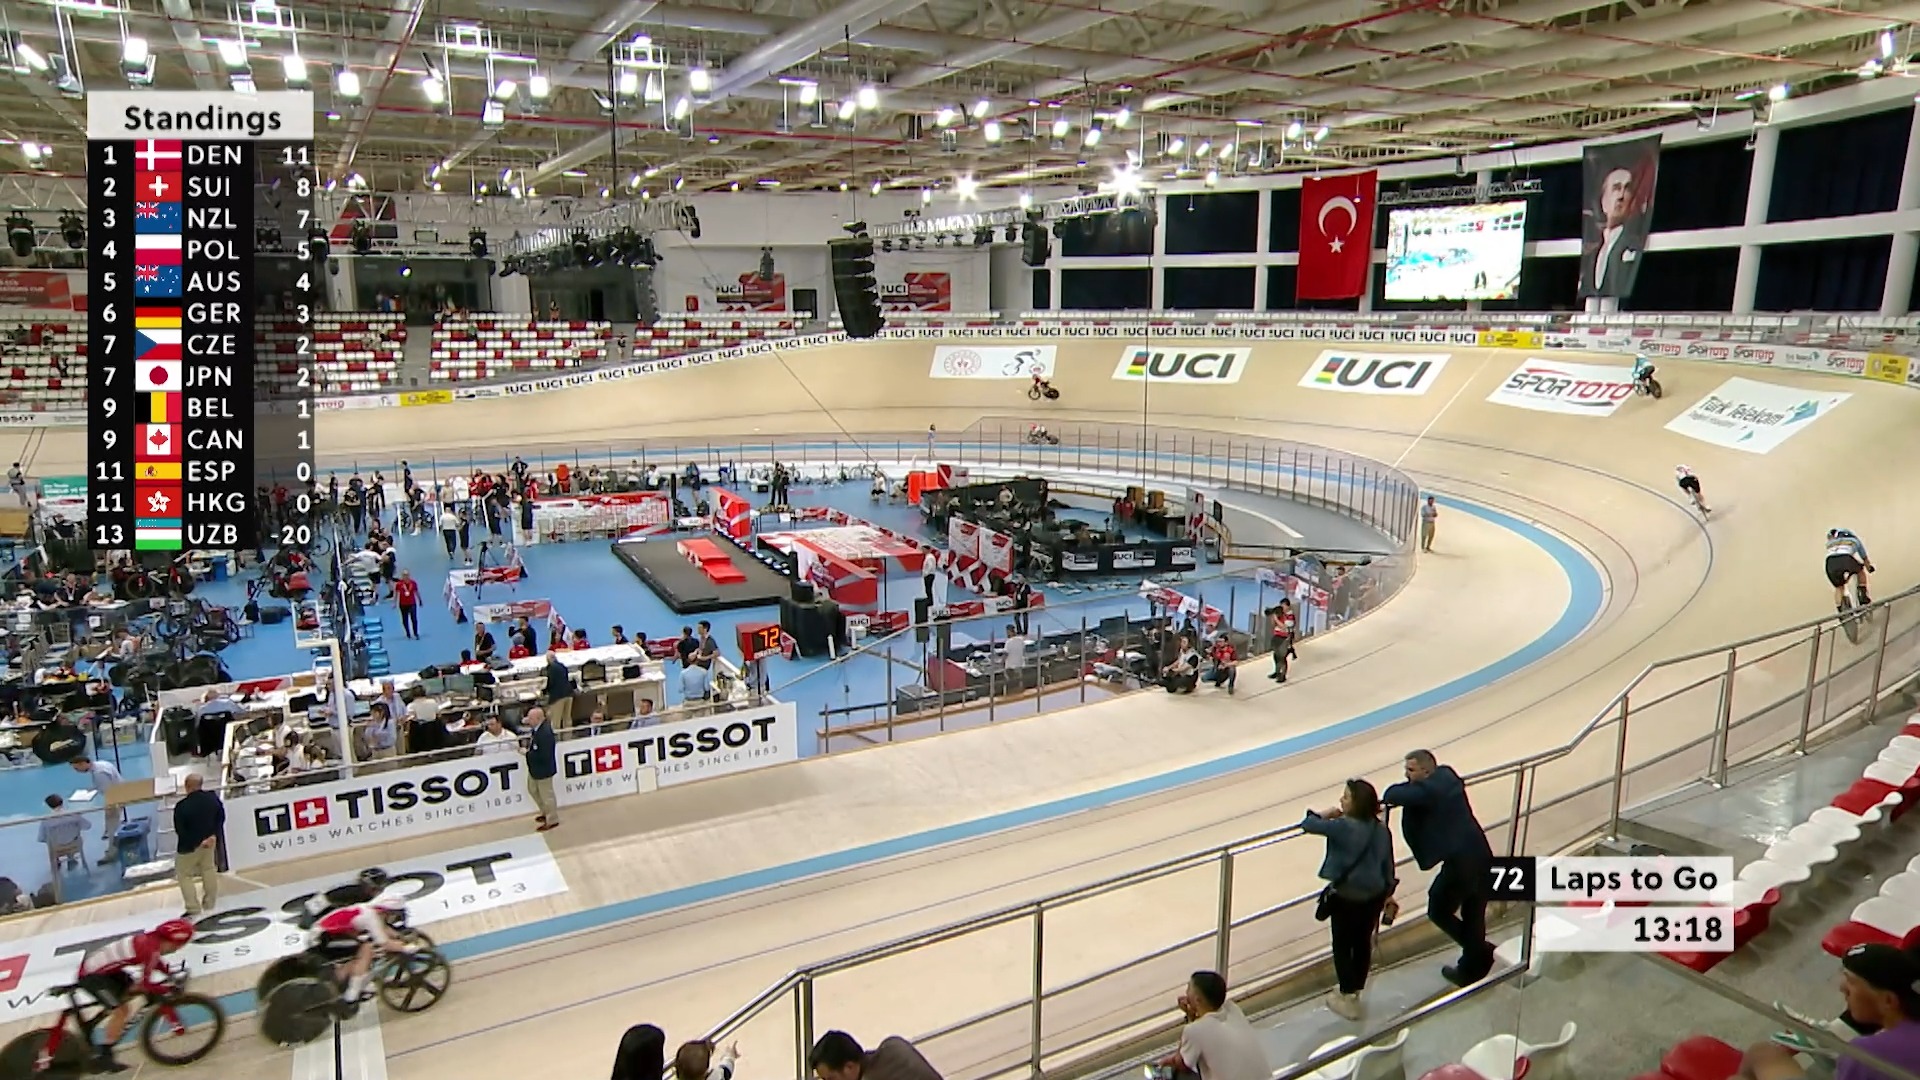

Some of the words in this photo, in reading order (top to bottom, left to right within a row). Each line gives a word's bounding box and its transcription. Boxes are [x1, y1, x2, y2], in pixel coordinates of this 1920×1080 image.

[721, 285, 742, 293] UCI
[886, 284, 906, 293] UCI
[896, 330, 915, 338] UCI
[922, 329, 943, 338] UCI
[953, 328, 973, 337] UCI
[982, 328, 1002, 337] UCI
[1010, 327, 1031, 336] UCI
[1040, 327, 1061, 336] UCI
[1069, 327, 1089, 336] UCI
[1097, 327, 1118, 336] UCI
[1127, 327, 1148, 336] UCI
[1156, 327, 1177, 336] UCI
[1184, 327, 1205, 336] UCI
[1215, 328, 1236, 337] UCI
[1244, 329, 1265, 338] UCI
[1273, 329, 1294, 338] UCI
[1303, 329, 1325, 338] UCI
[1333, 330, 1354, 339] UCI
[1363, 330, 1384, 339] UCI
[1395, 331, 1416, 341] UCI
[1424, 332, 1445, 342] UCI
[1454, 333, 1476, 343] UCI
[509, 383, 532, 394] UCI
[541, 379, 562, 390] UCI
[571, 375, 593, 386] UCI
[603, 369, 625, 380] UCI
[632, 364, 654, 375] UCI
[662, 359, 683, 370] UCI
[691, 353, 713, 364] UCI
[722, 348, 743, 359] UCI
[750, 343, 772, 354] UCI
[780, 339, 801, 349] UCI
[808, 335, 828, 345] UCI
[1149, 353, 1237, 379] UCI
[1337, 359, 1433, 389] UCI
[1506, 373, 1634, 400] SPORTOTO
[759, 627, 780, 648] 72
[628, 716, 776, 765] TISSOT
[566, 777, 613, 793] SWISS
[699, 752, 741, 768] SINCE
[335, 762, 519, 819] TISSOT
[258, 833, 318, 853] SWISS
[328, 814, 415, 839] WATCHES
[424, 802, 476, 821] SINCE
